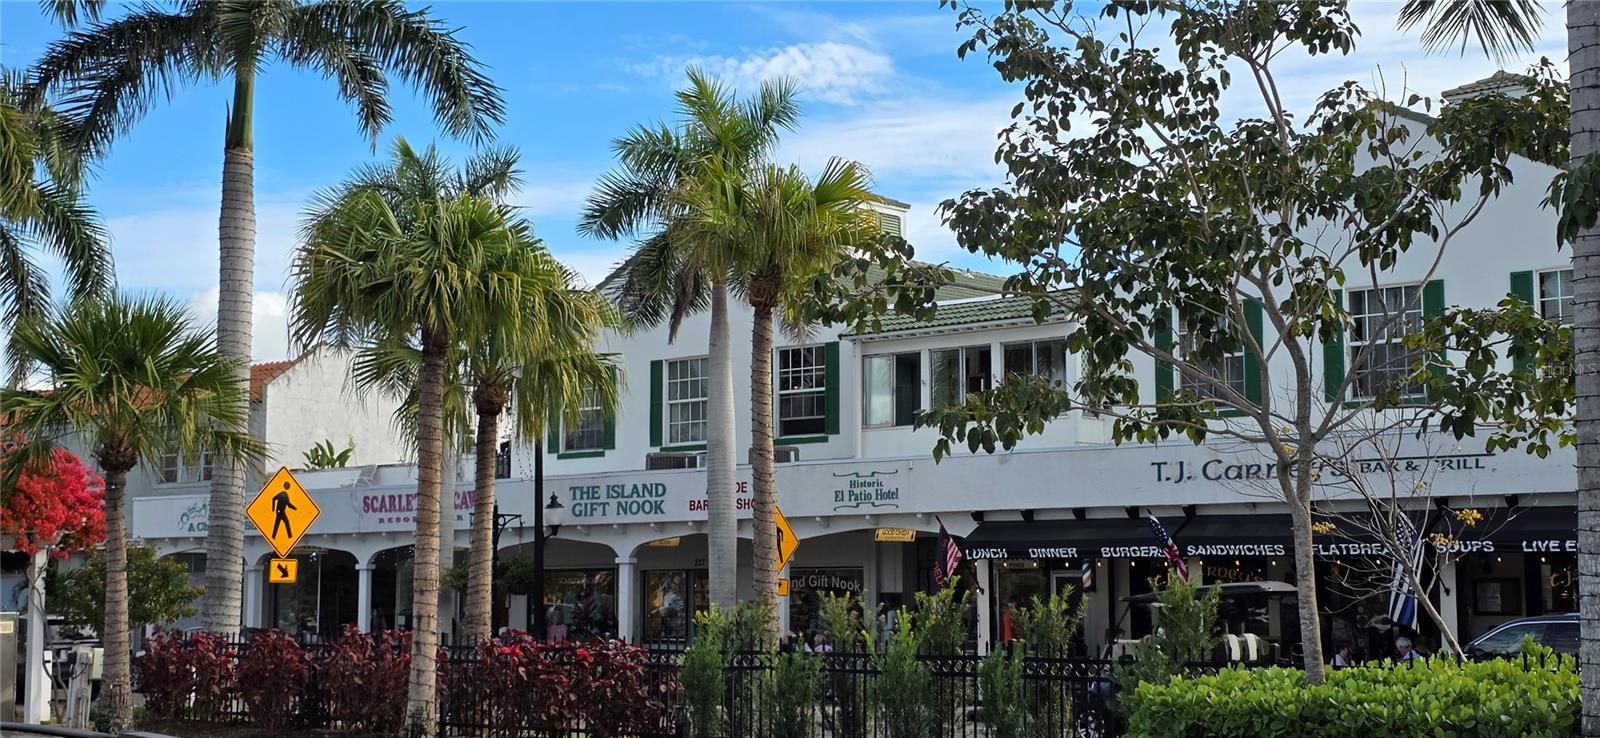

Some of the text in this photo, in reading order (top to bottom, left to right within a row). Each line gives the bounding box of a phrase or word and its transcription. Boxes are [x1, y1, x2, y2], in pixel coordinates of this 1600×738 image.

[1151, 460, 1192, 484] T.J.
[1405, 460, 1421, 472] &
[1430, 457, 1486, 471] RILL
[849, 478, 884, 489] Historic
[569, 483, 667, 501] THE ISLAND
[834, 487, 899, 502] El Patio Hotel
[571, 500, 665, 517] GIFT NOOK
[1186, 544, 1285, 556] SANDWICHES
[1436, 540, 1494, 553] SOUPS
[1521, 540, 1560, 552] LIVE
[965, 547, 1008, 560] LUNCH
[1029, 547, 1078, 559] DINNER
[808, 575, 828, 588] Gift
[832, 575, 861, 592] Nook
